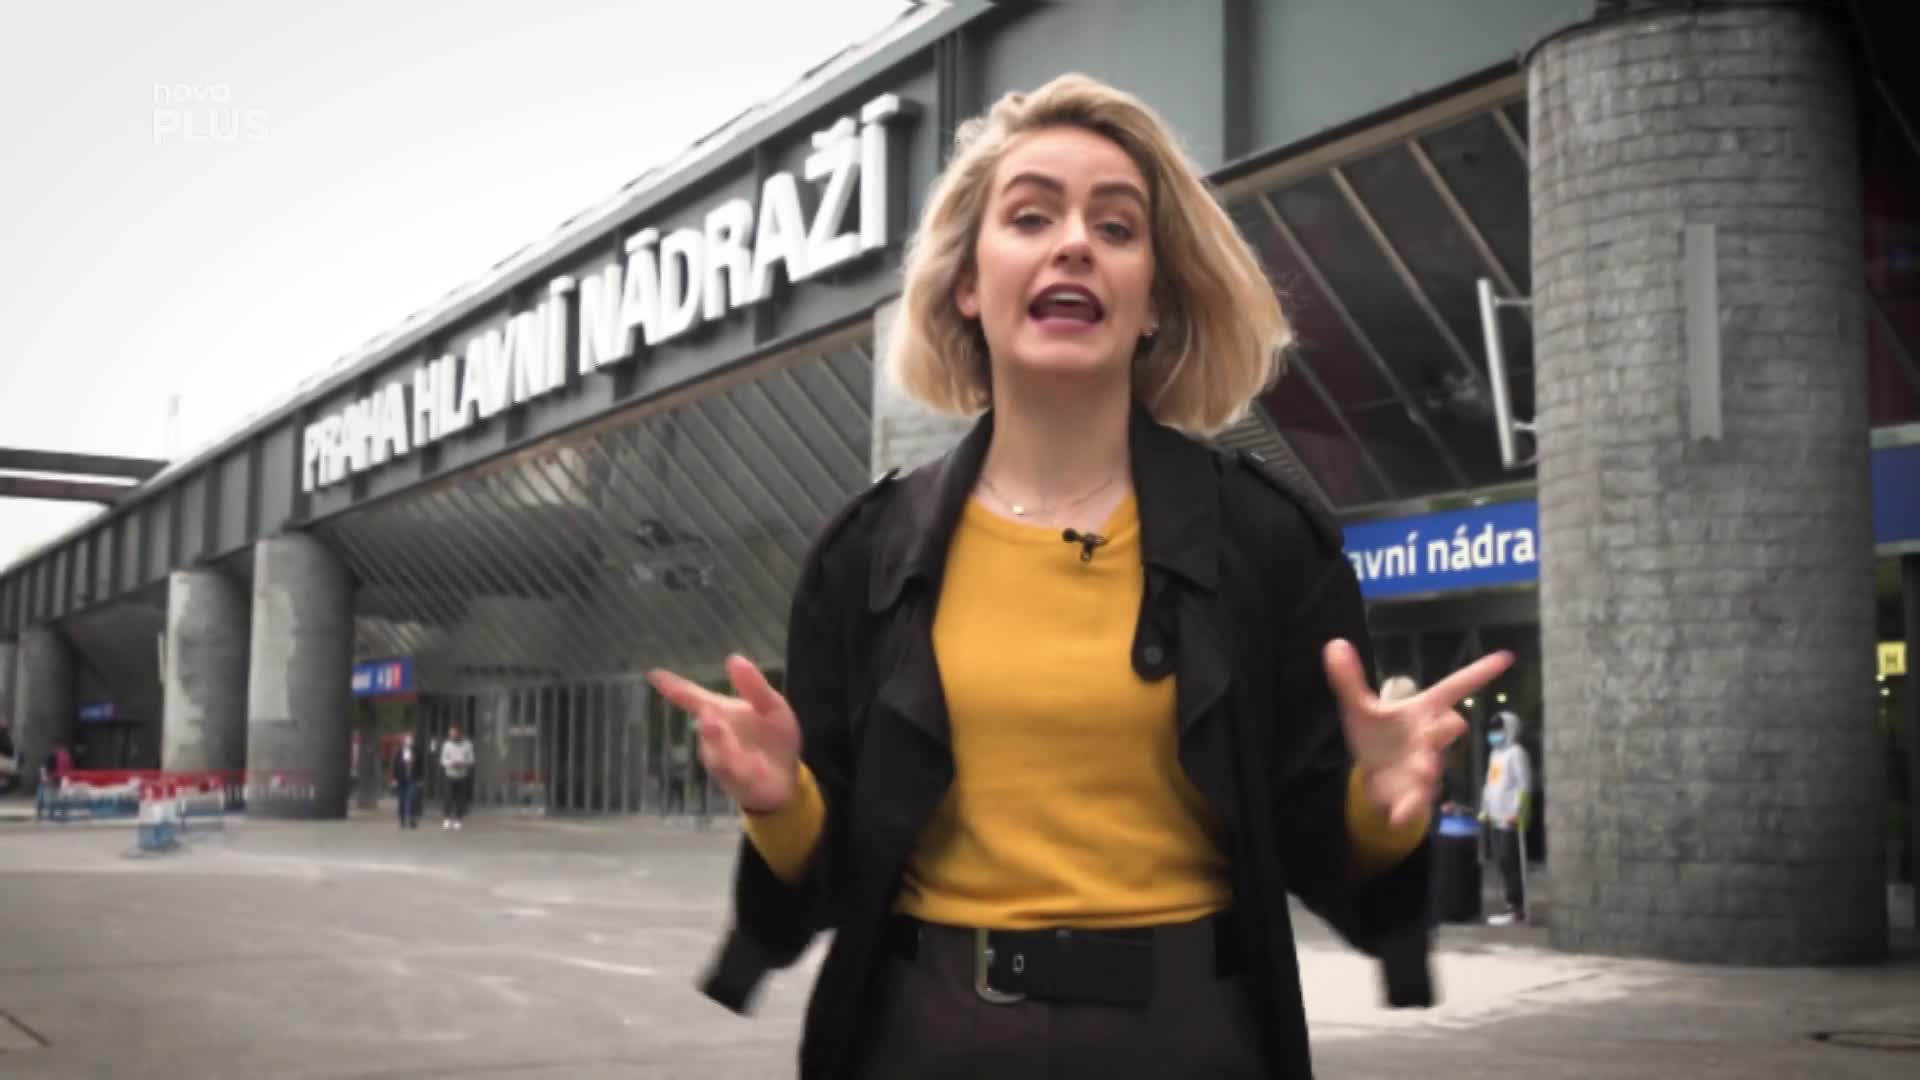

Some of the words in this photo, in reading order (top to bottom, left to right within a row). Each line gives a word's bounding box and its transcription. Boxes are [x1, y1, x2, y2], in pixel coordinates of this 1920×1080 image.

[303, 383, 408, 492] PRAHA
[413, 275, 575, 447] HLAVNÍ
[579, 94, 899, 375] NÁDRAŽÍ
[1427, 522, 1536, 573] nádra
